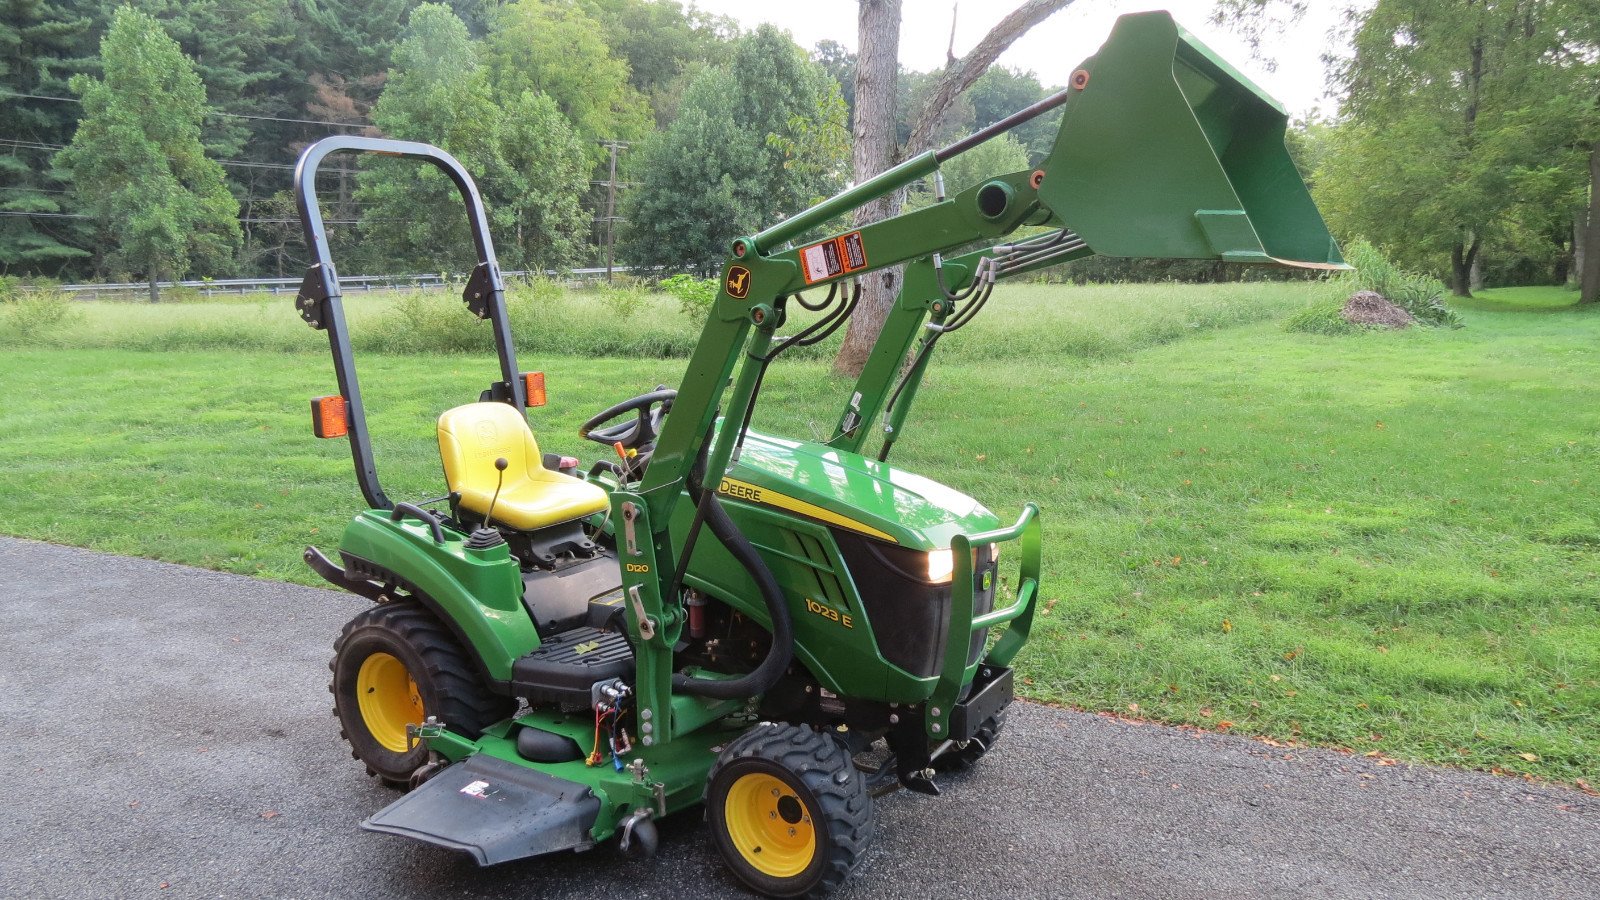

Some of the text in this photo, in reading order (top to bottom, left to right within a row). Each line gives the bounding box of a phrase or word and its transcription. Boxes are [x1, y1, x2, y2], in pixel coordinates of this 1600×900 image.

[720, 480, 761, 500] DEERE
[805, 598, 853, 629] 1023 E
